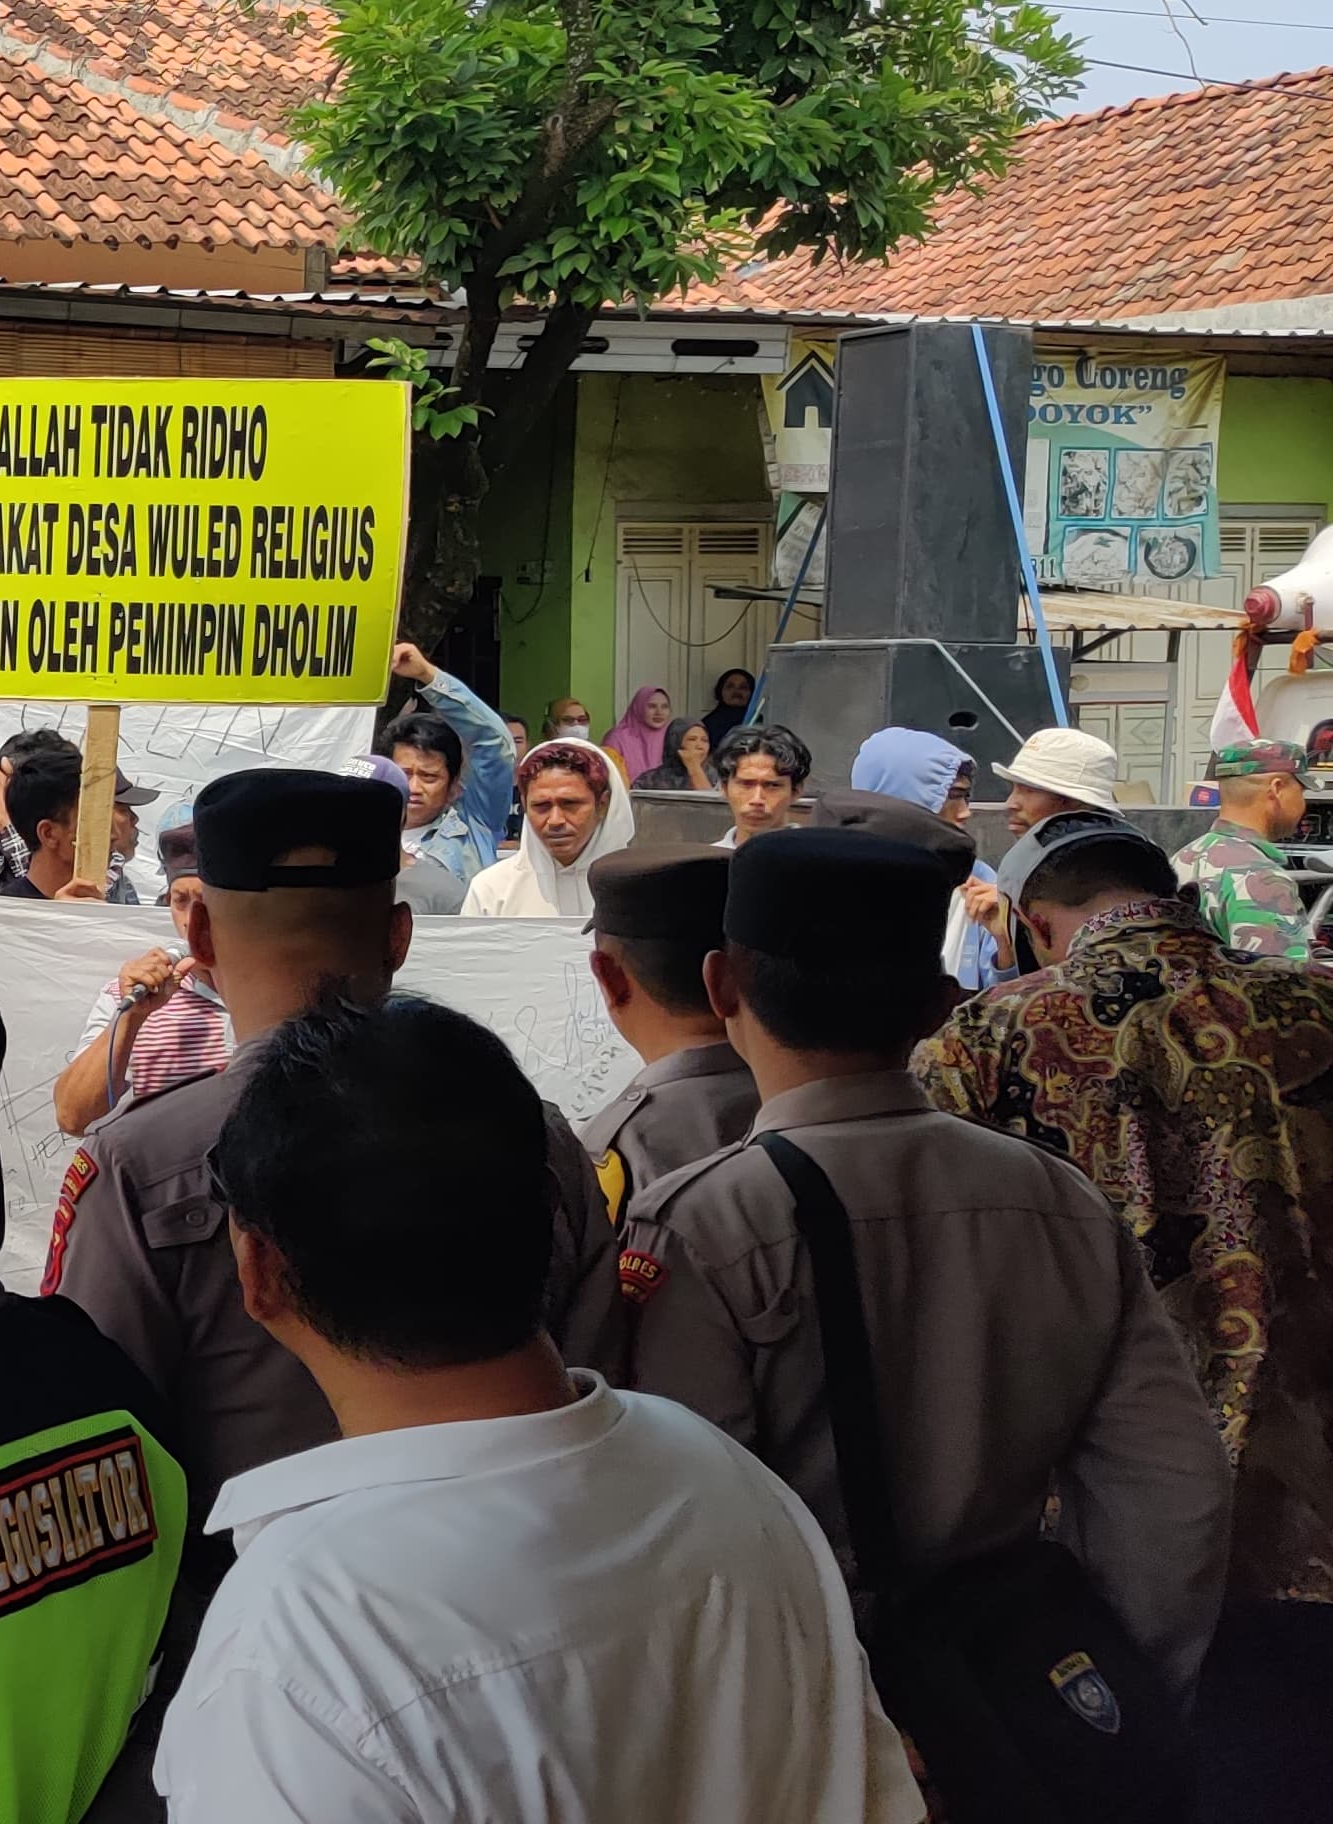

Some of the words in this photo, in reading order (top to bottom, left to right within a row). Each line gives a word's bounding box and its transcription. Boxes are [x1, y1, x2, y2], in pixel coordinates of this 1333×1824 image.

[1076, 355, 1188, 399] Goreng
[91, 404, 173, 479] TIDAK
[180, 405, 268, 481] RIDHO
[66, 502, 137, 577] DESA
[148, 503, 242, 579] WULED
[250, 505, 376, 582] RELIGIUS
[27, 598, 98, 674] OLEH
[108, 603, 245, 676] PEMIMPIN
[251, 603, 358, 678] DHOLIM
